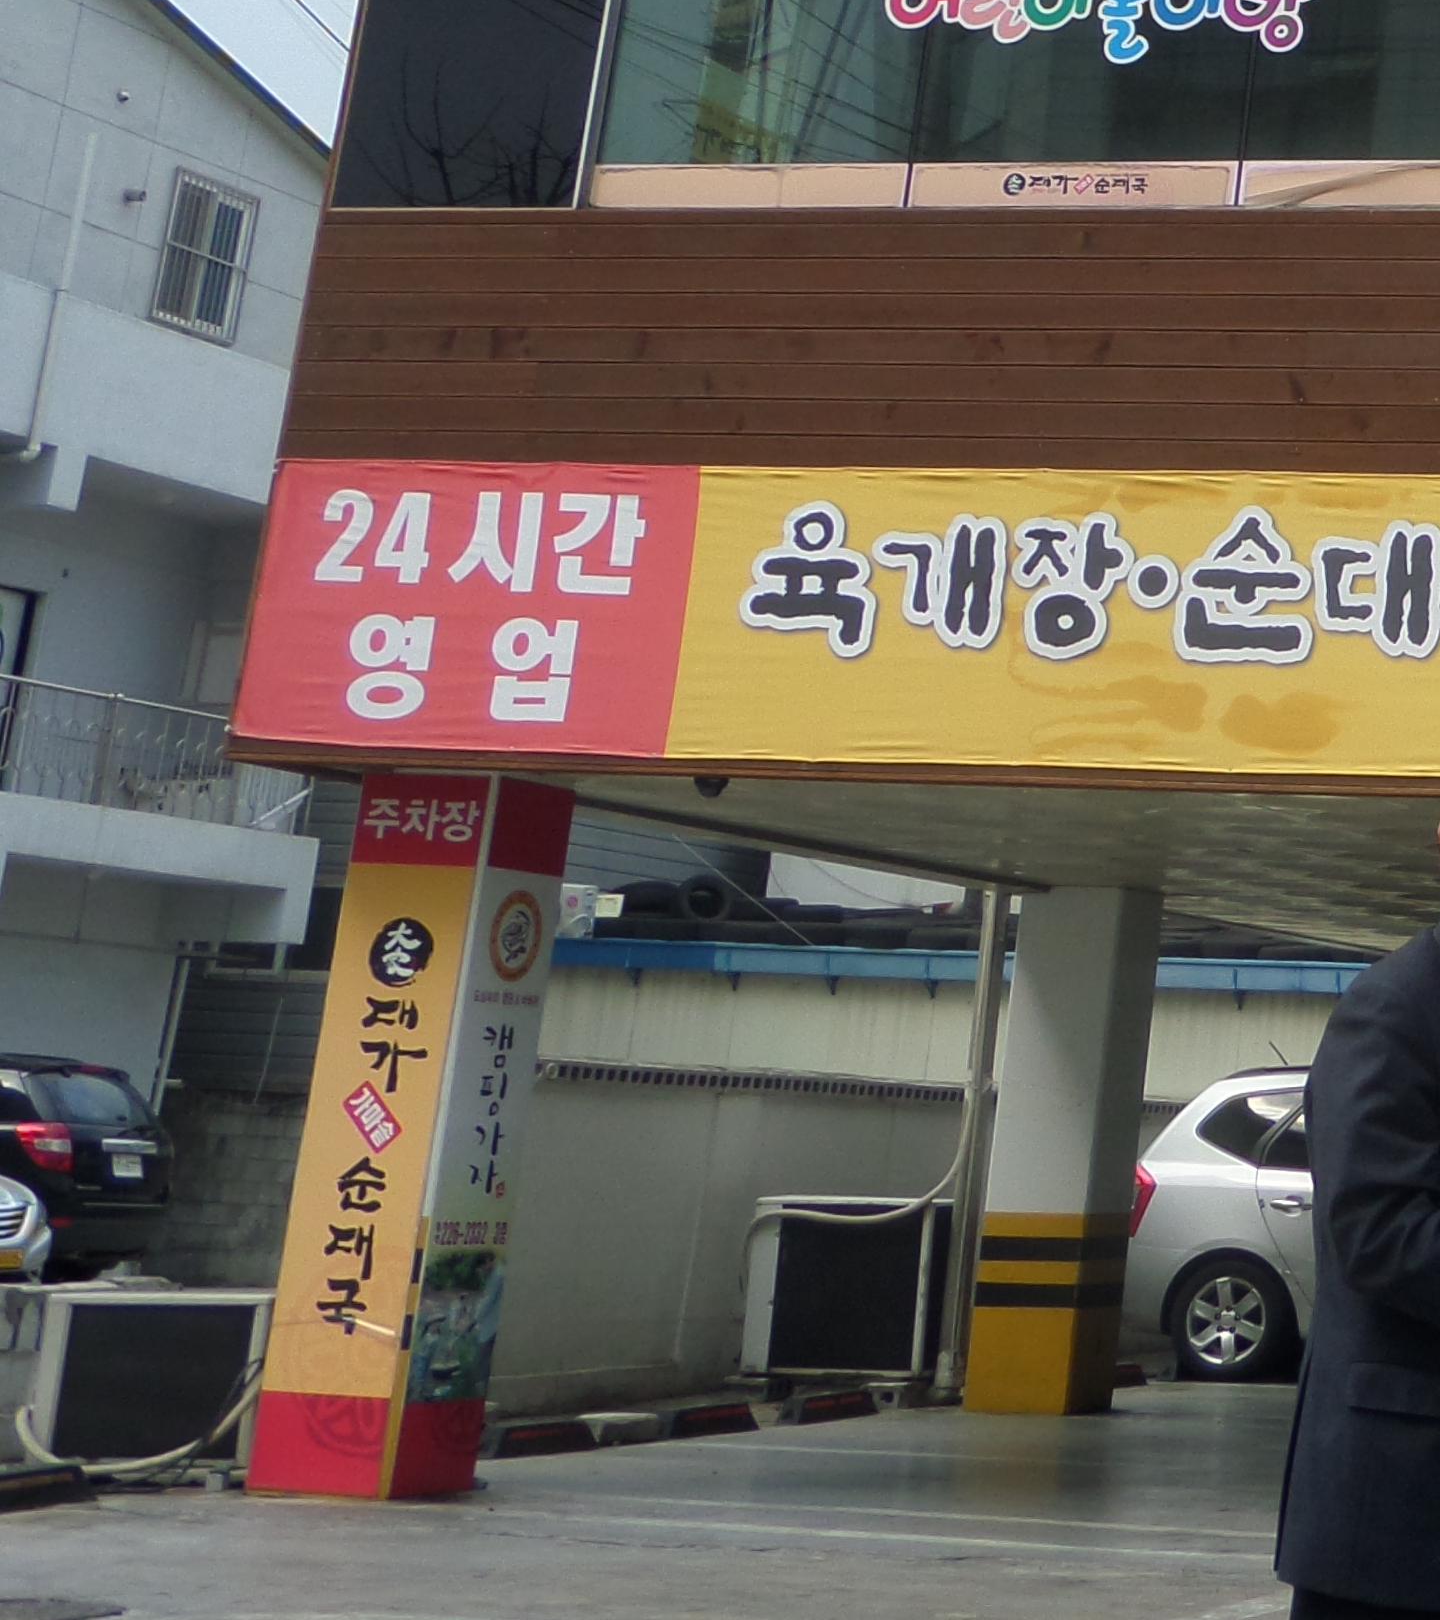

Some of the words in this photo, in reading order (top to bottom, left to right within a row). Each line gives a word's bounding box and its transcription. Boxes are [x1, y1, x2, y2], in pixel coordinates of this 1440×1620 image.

[316, 488, 647, 595] 24시간
[346, 612, 579, 724] 영업
[364, 796, 481, 843] 주차장
[349, 1088, 396, 1149] 가마솥
[468, 1023, 516, 1196] 캠핑가자
[316, 1156, 387, 1335] 순대국
